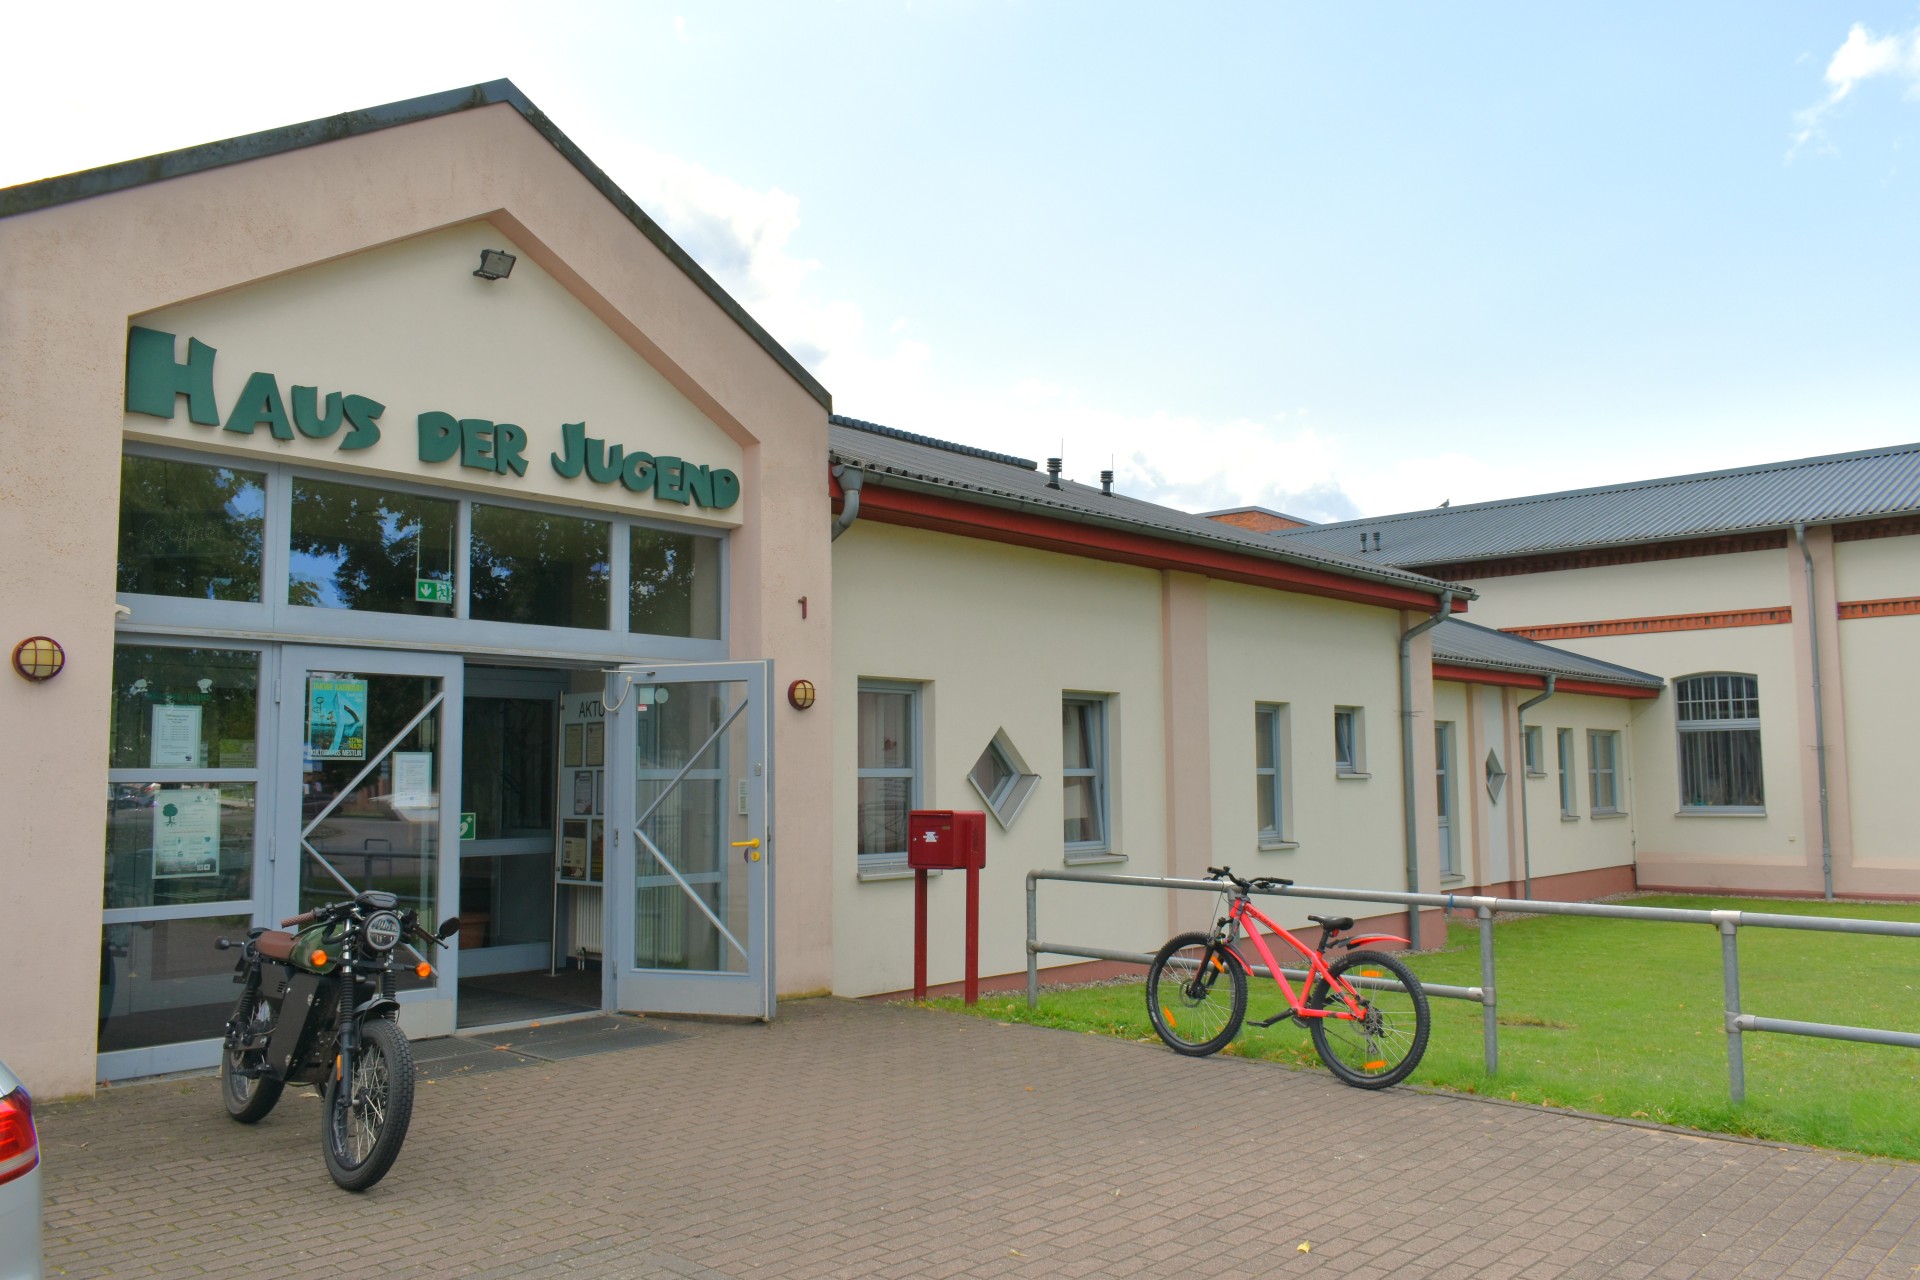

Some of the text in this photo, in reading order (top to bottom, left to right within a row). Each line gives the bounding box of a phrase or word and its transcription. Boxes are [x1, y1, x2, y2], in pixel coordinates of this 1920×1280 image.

[126, 325, 740, 509] HAUS DER JUGEND
